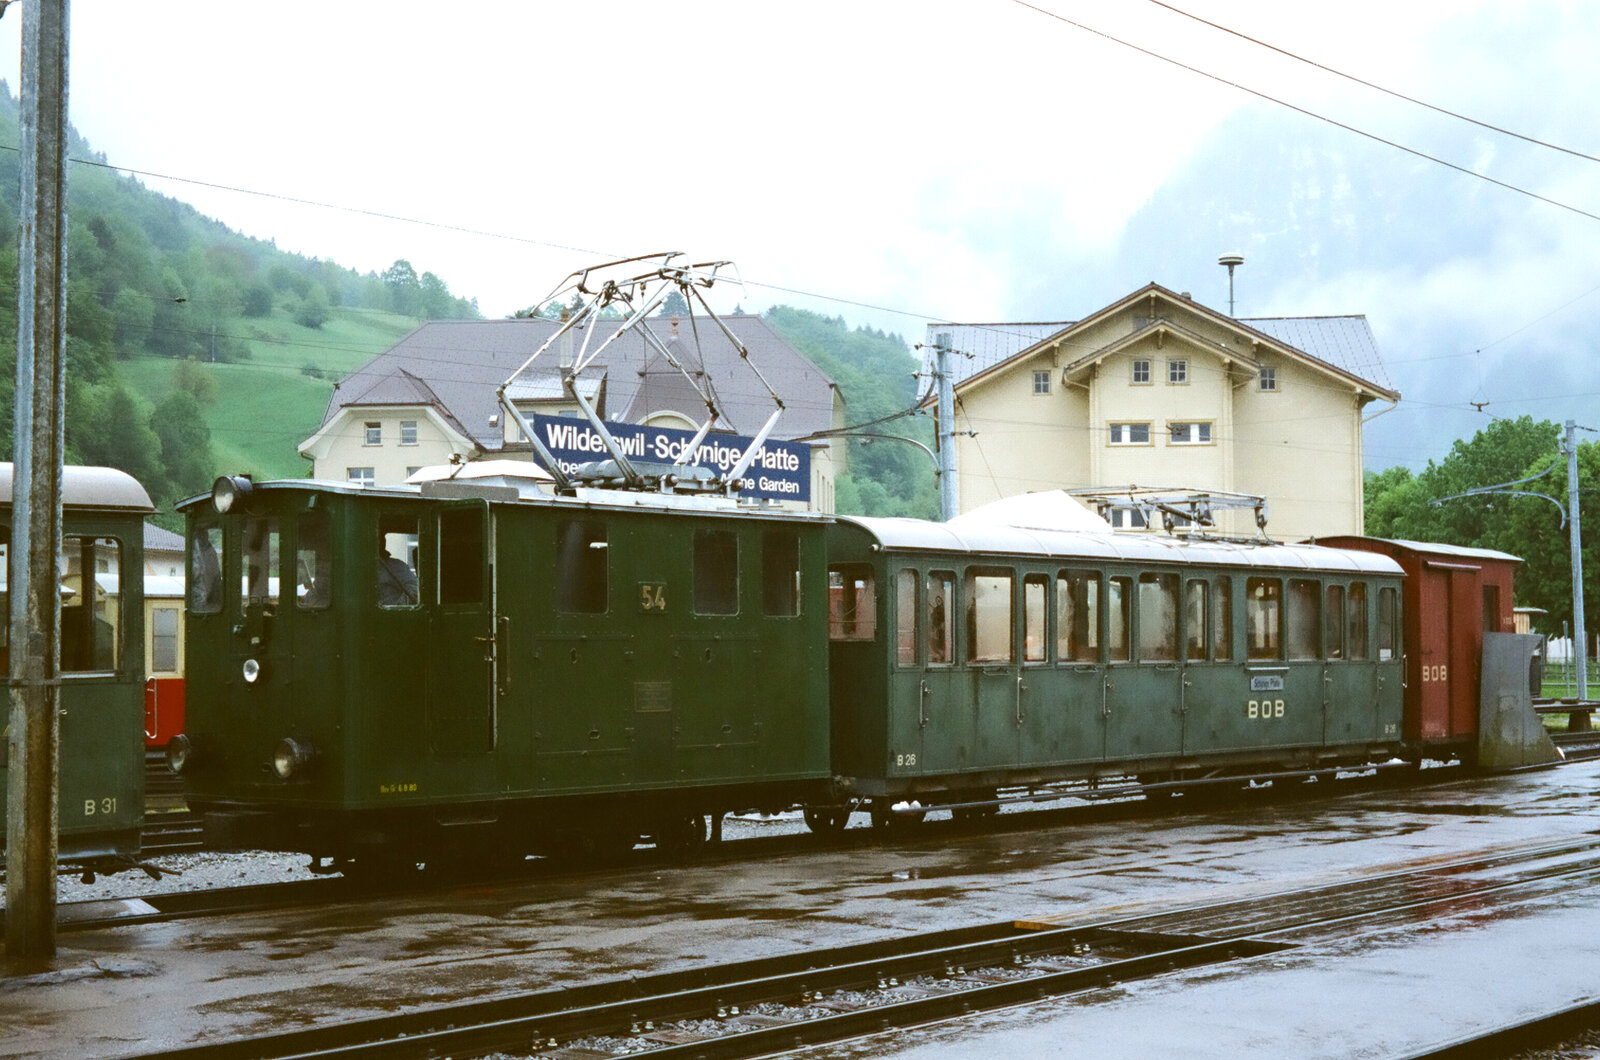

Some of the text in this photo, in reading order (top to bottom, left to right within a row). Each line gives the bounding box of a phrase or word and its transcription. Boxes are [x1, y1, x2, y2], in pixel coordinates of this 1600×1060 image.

[751, 446, 799, 471] Platte
[759, 476, 799, 493] Garden
[642, 585, 666, 610] 54
[1422, 665, 1447, 681] BOB
[1248, 700, 1285, 718] BOB
[897, 754, 916, 766] B 26
[84, 797, 117, 815] B 31
